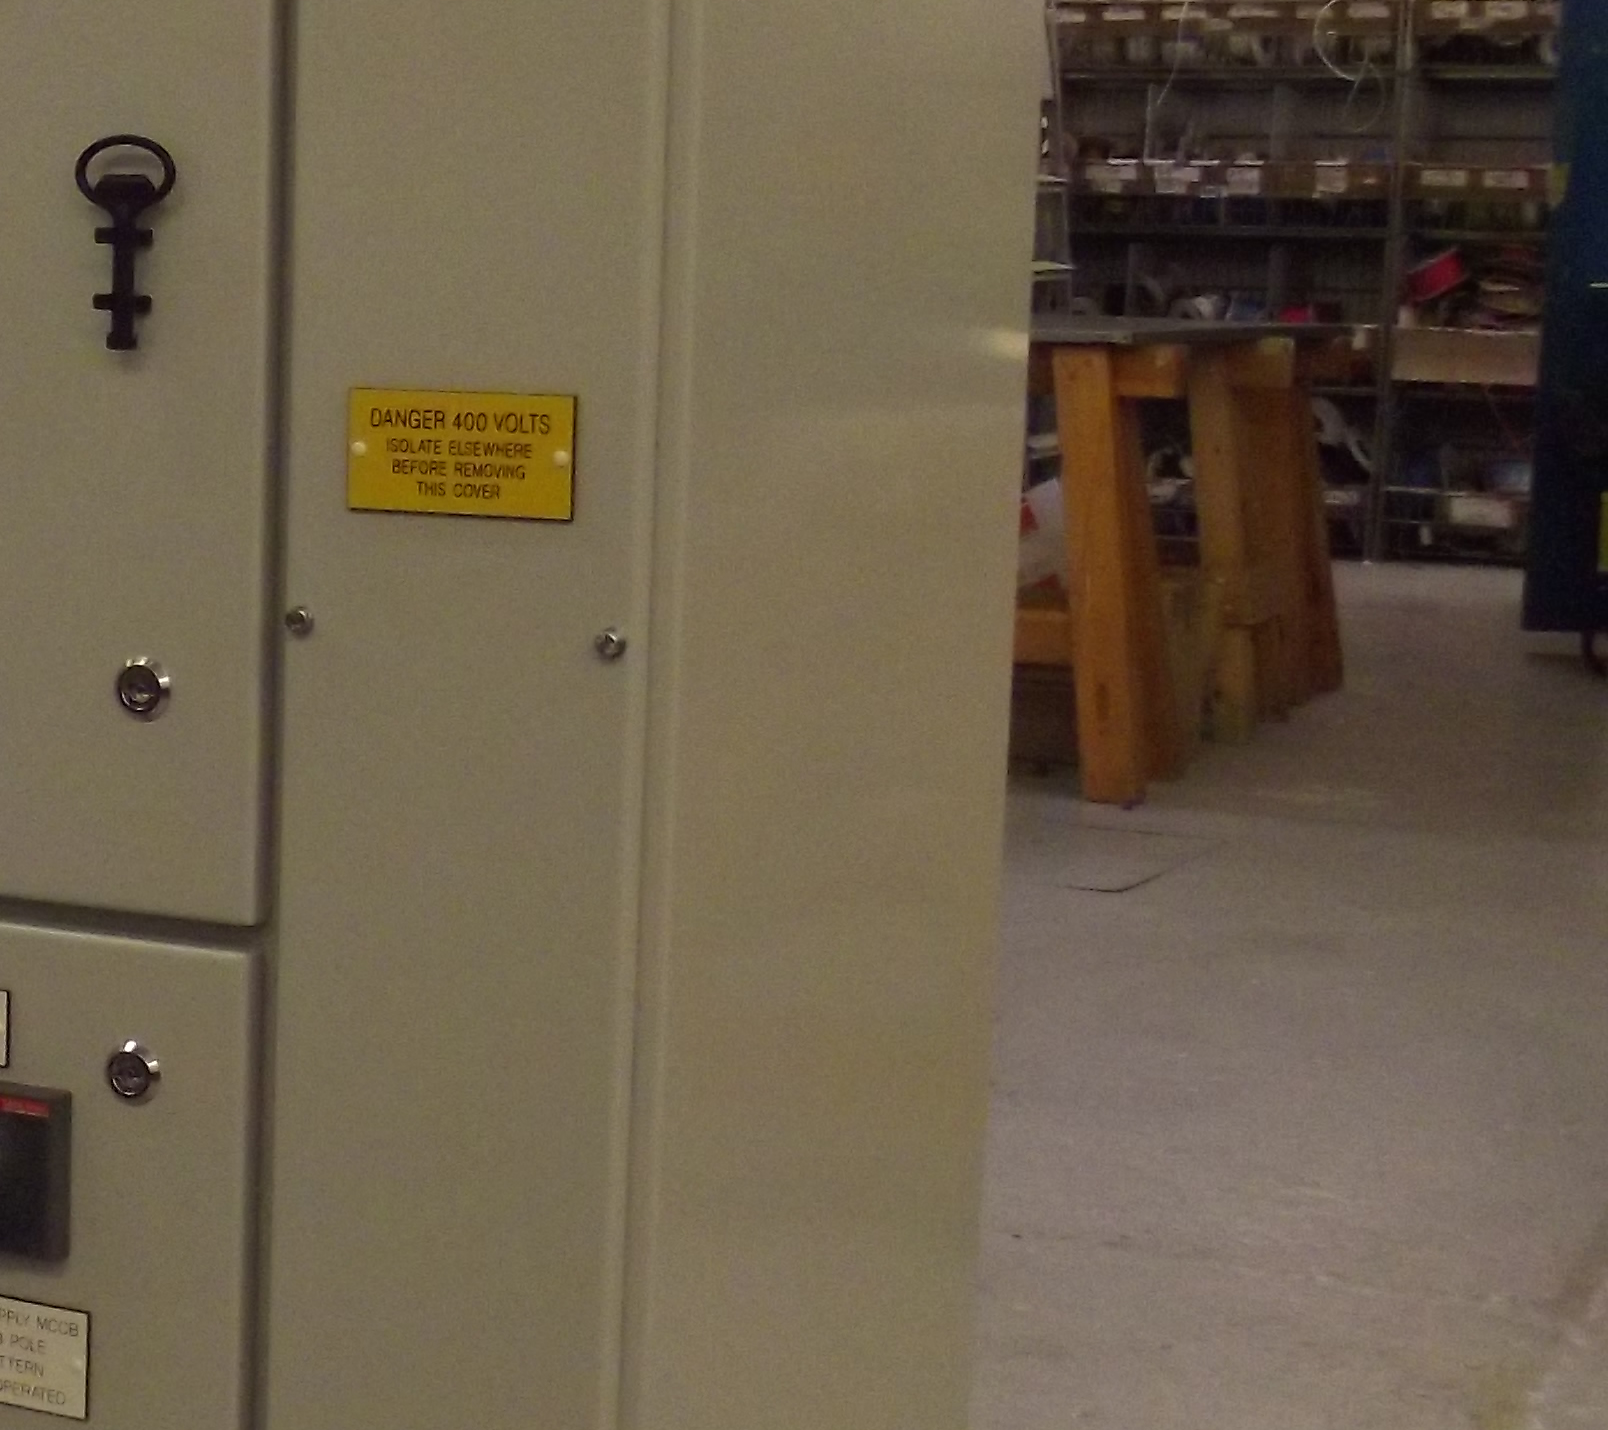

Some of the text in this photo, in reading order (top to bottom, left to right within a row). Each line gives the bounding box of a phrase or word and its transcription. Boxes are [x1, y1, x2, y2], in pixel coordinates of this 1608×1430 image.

[370, 407, 551, 435] DANGER 400 VOLTS
[387, 438, 533, 459] ISOLATE ELSEWHERE
[392, 459, 525, 480] BEFORE REMOVING
[416, 481, 501, 500] THIS COVER
[36, 1316, 79, 1337] MCCB
[10, 1334, 47, 1356] POLE
